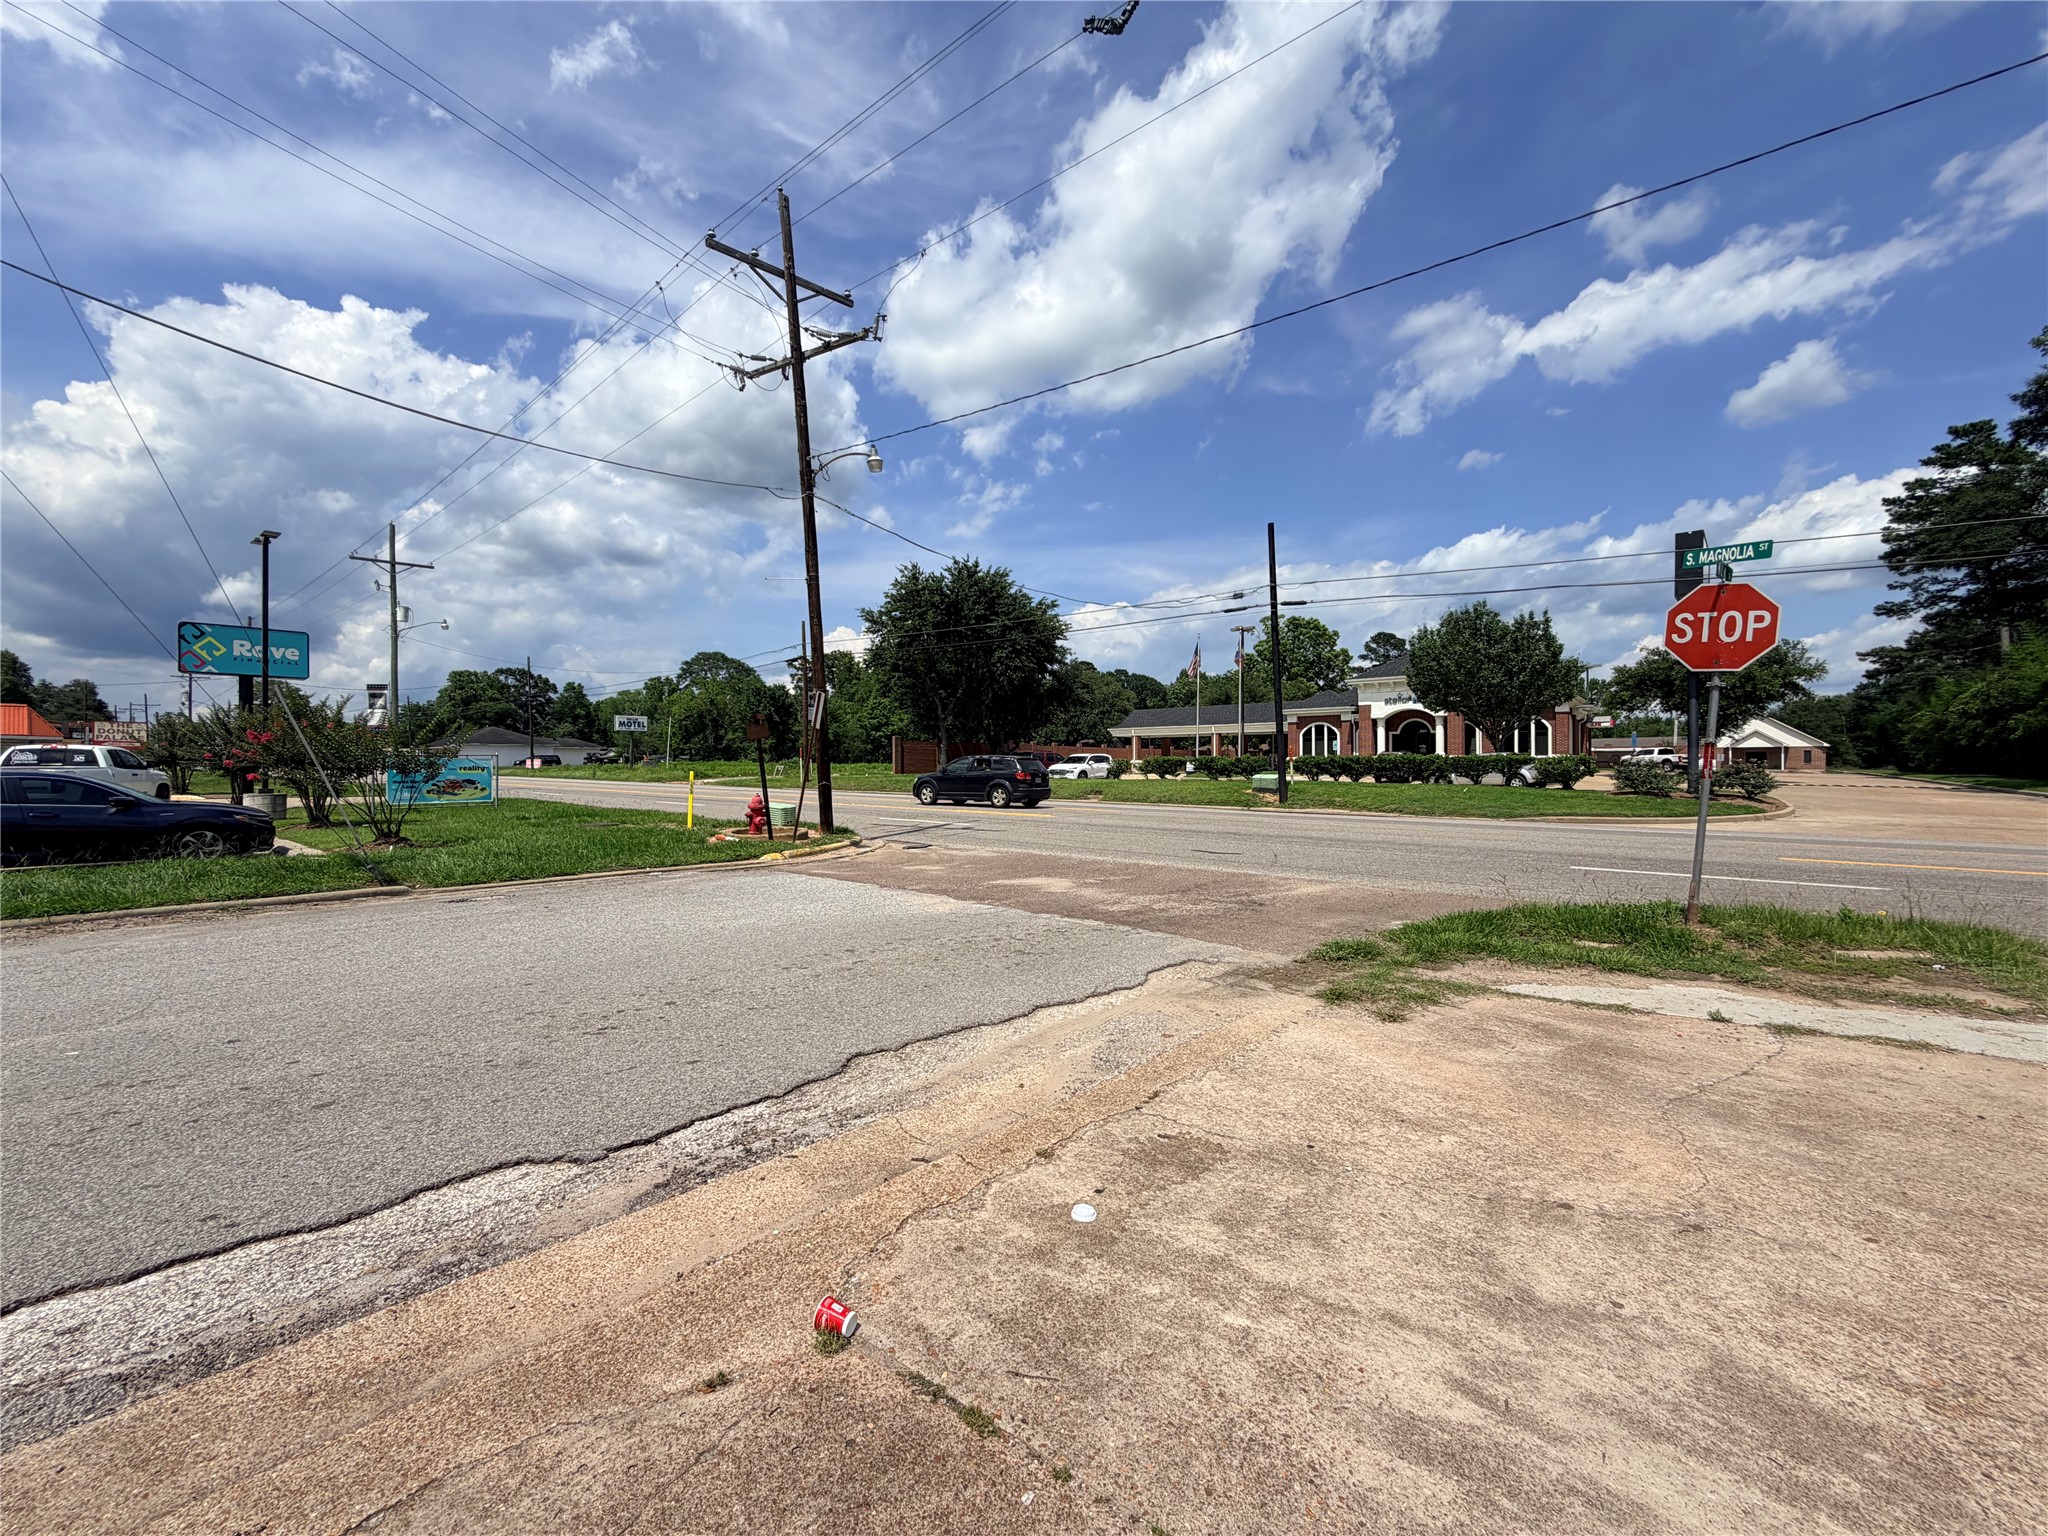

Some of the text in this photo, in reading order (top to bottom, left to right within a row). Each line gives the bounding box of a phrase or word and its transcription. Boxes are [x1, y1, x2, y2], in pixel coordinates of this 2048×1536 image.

[1686, 543, 1769, 566] S. MAGNOLIA ST
[1671, 610, 1772, 644] STOP
[233, 657, 299, 666] FINACIAL
[619, 720, 646, 728] MOTEL
